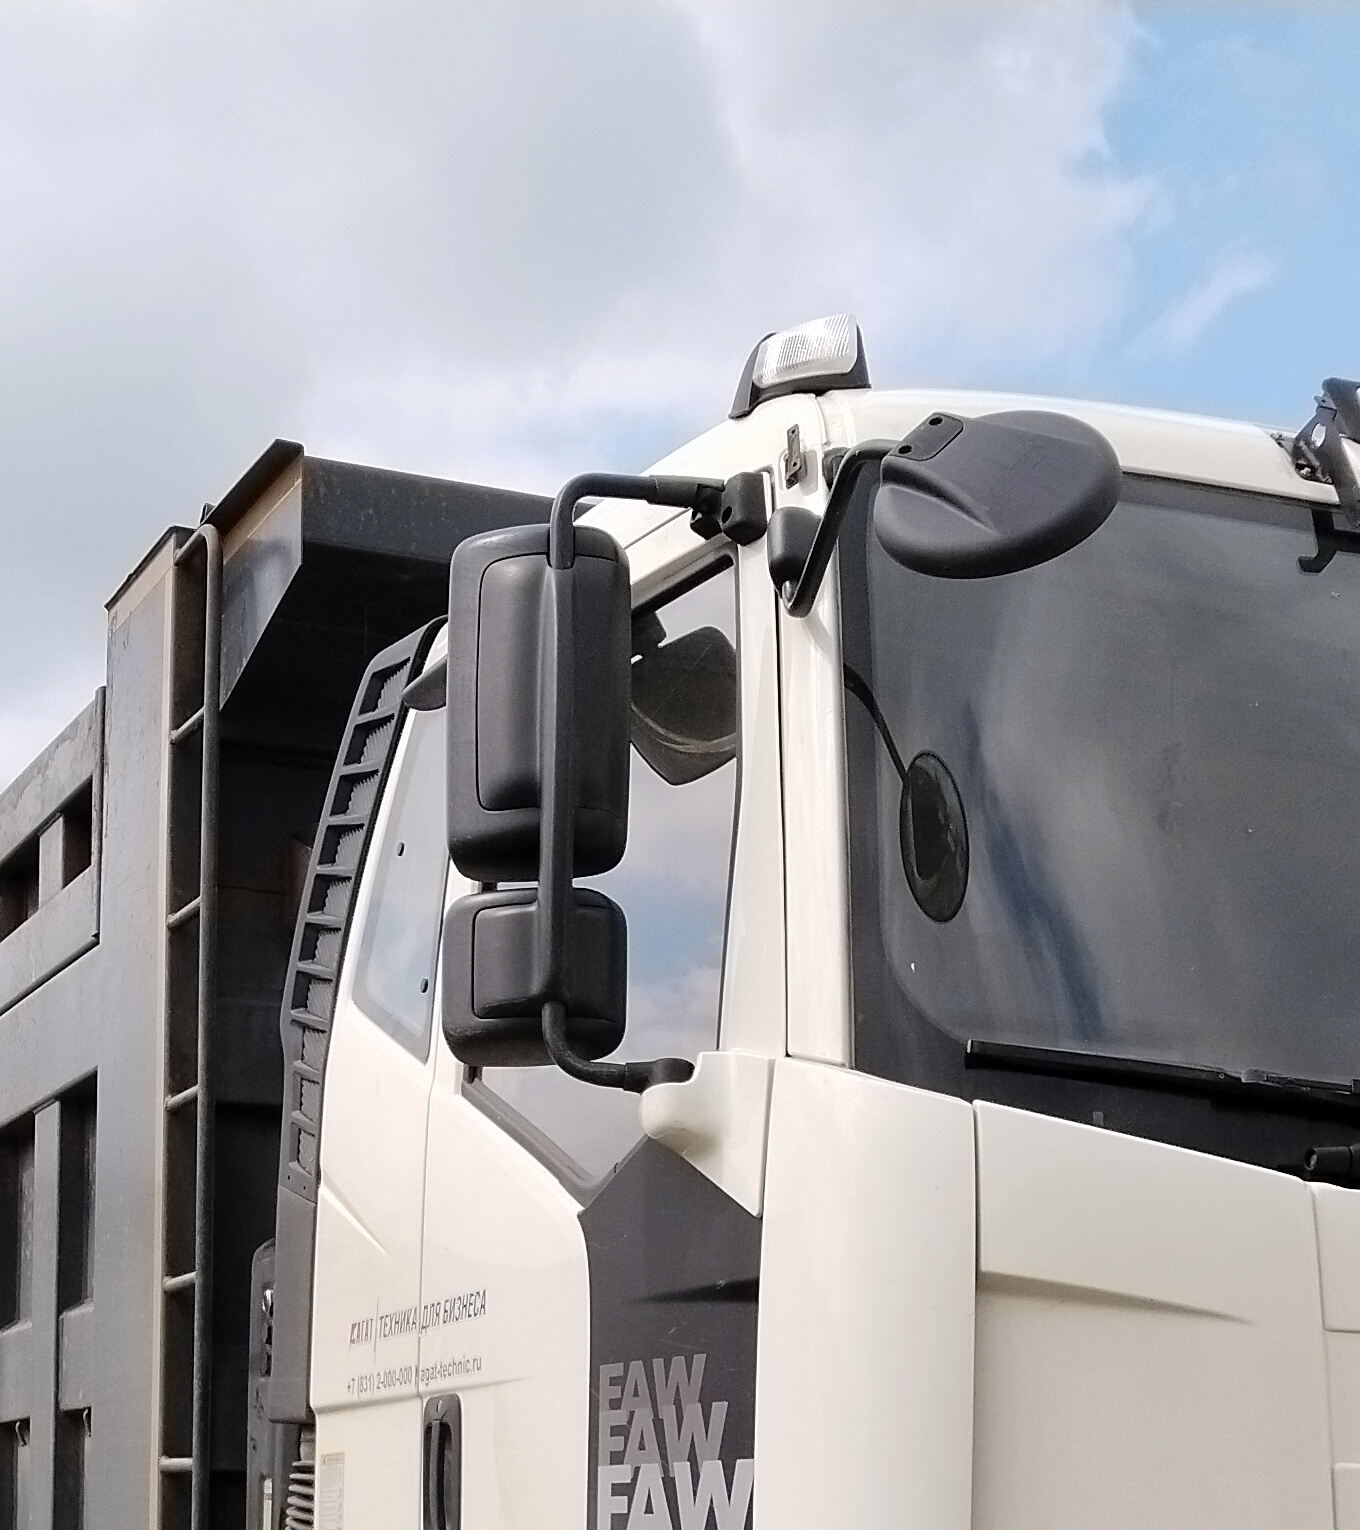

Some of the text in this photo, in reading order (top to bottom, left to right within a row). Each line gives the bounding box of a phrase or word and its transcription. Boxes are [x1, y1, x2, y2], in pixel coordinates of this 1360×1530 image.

[378, 1306, 418, 1340] ТЕХНИКА
[421, 1301, 441, 1335] ДЛЯ
[442, 1289, 487, 1325] БИЗНЕСА
[421, 1355, 482, 1388] agat-technic.ru
[599, 1353, 707, 1418] FAW
[598, 1401, 729, 1478] FAW
